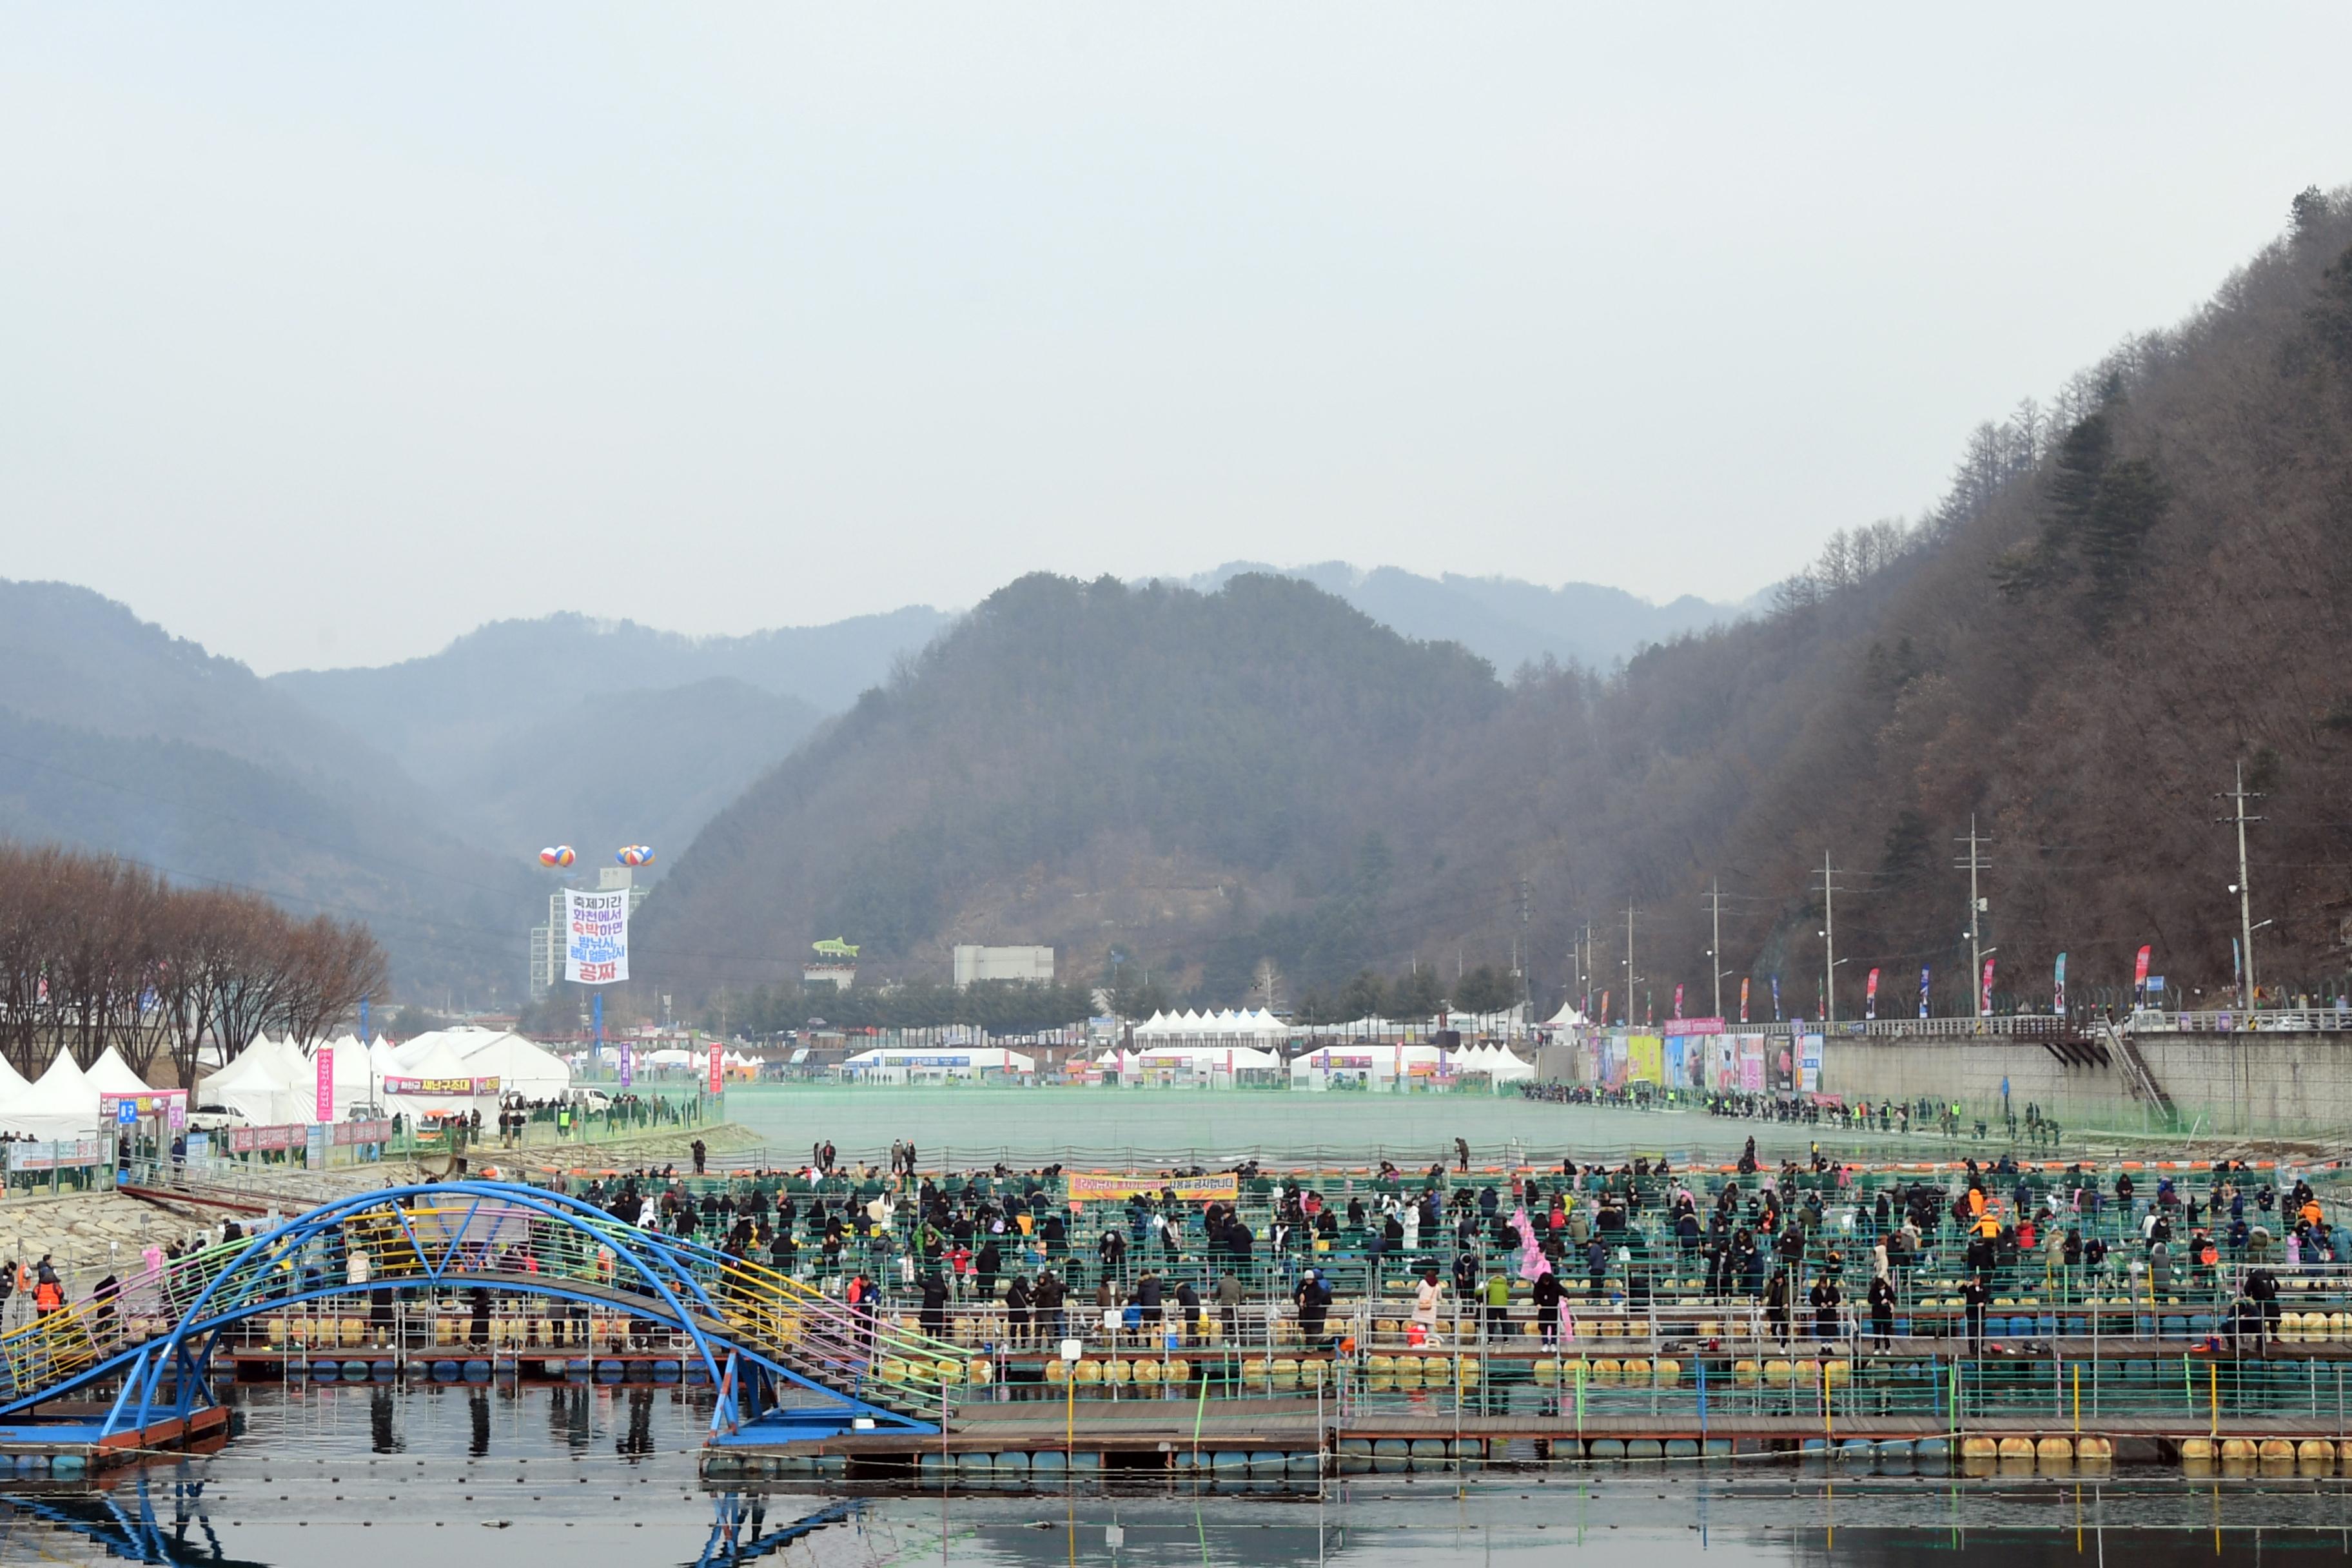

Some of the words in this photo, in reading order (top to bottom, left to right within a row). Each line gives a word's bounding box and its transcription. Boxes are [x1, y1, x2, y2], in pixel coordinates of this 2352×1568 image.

[574, 896, 622, 910] 축제기간
[574, 908, 622, 923] 화천에서
[573, 921, 623, 937] 숙박하면
[571, 945, 587, 962] 평일
[589, 945, 625, 963] 얼음낚시
[579, 961, 616, 981] 공짜
[422, 1079, 471, 1092] 재난구조대
[1170, 1179, 1192, 1190] 사용을
[1193, 1177, 1234, 1190] 금지합니다
